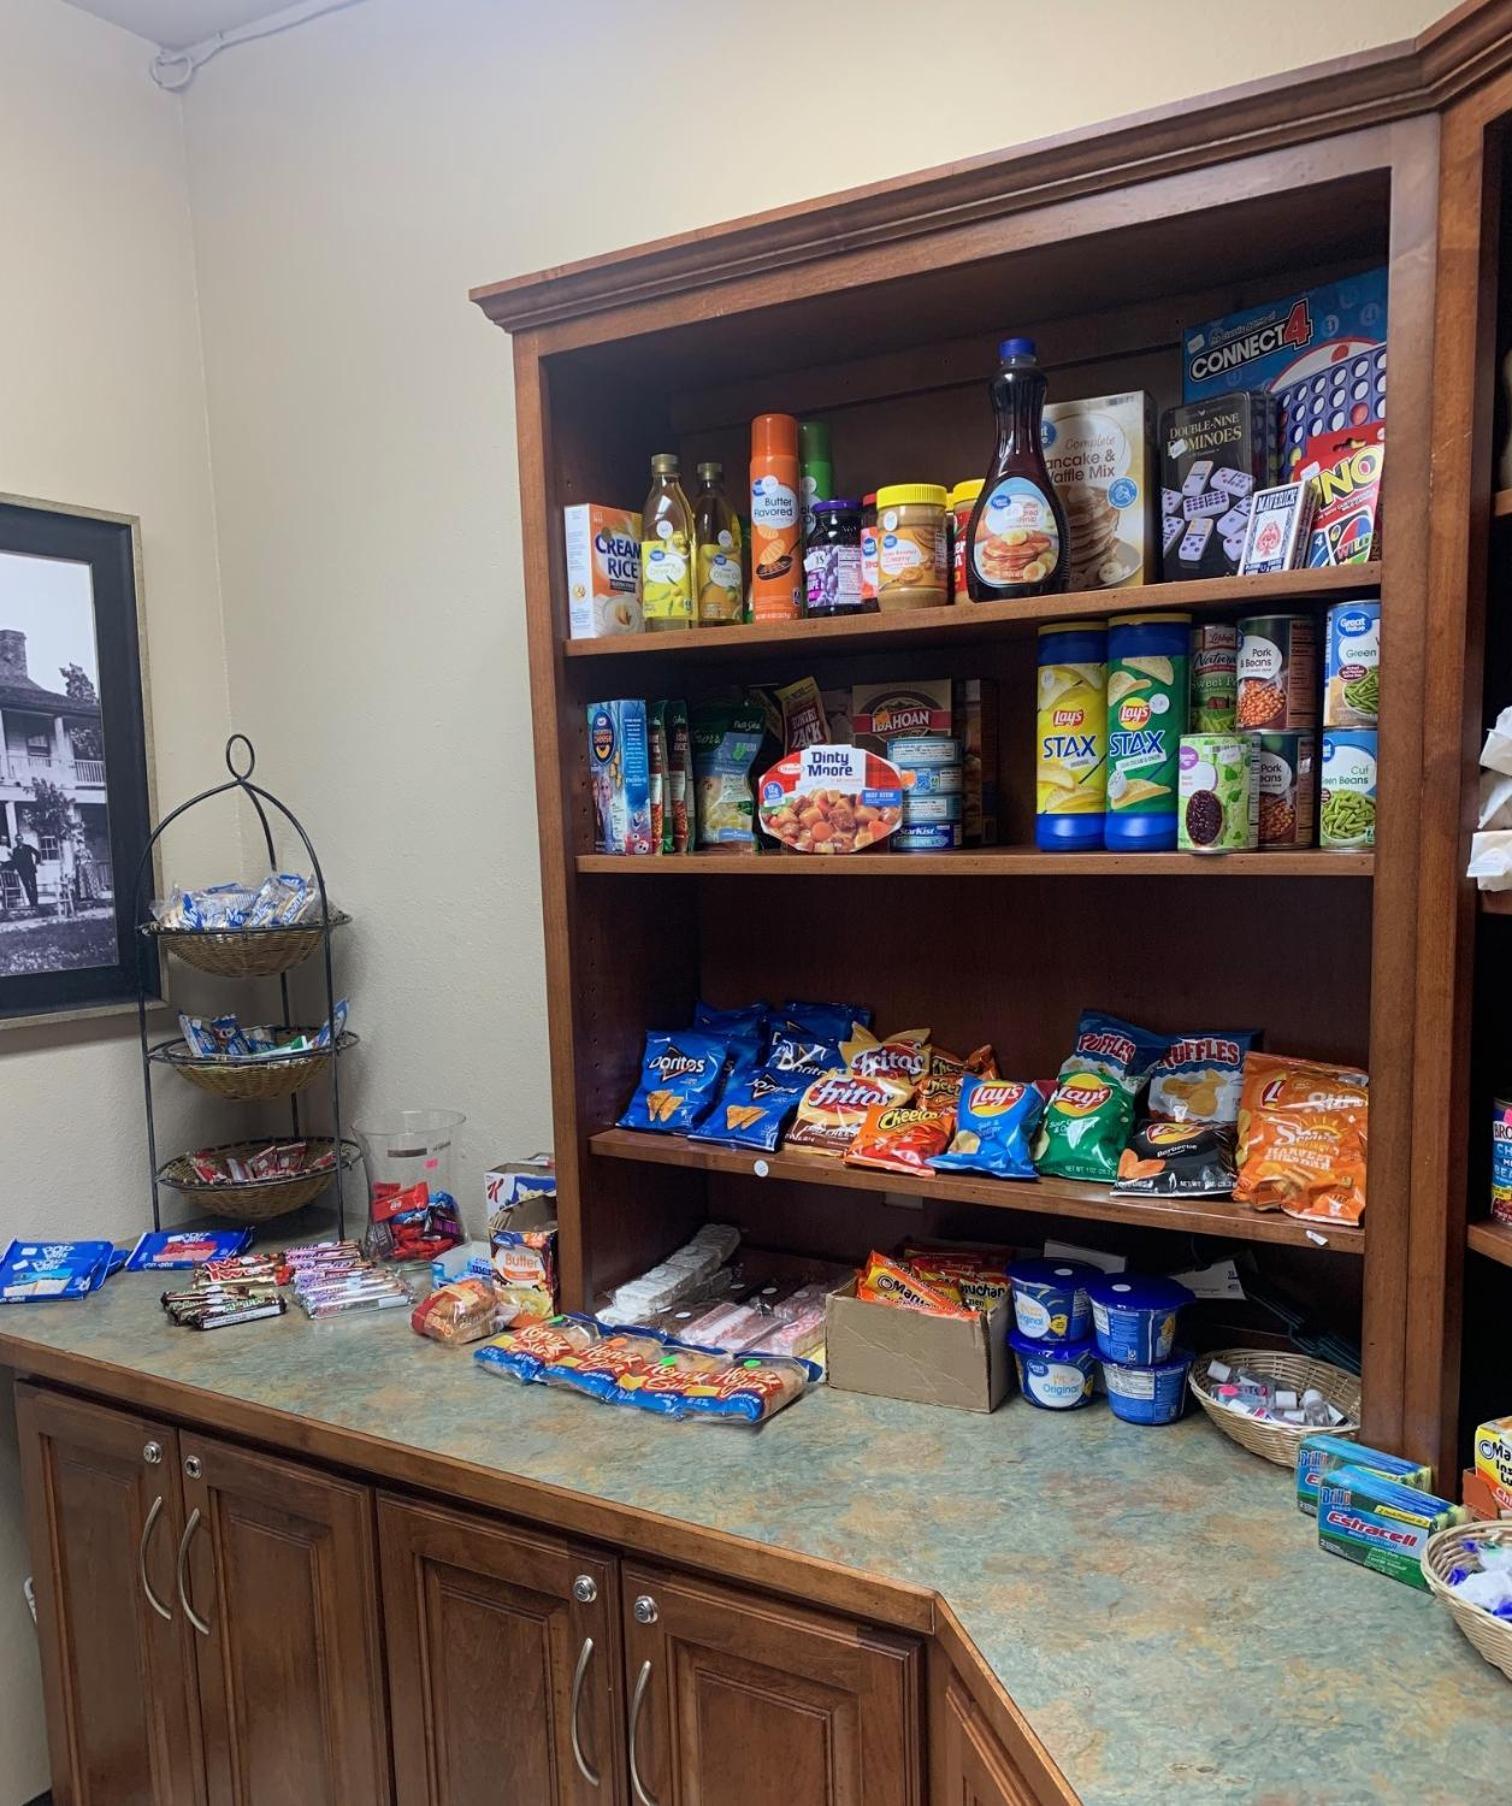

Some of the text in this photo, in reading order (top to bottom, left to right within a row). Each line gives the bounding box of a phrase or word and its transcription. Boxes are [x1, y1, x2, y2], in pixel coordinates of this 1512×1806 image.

[1191, 322, 1286, 379] CONNECT
[1283, 299, 1312, 348] 4
[1169, 412, 1240, 440] DOUBLE-NINE
[1065, 435, 1116, 450] Complete
[1047, 450, 1116, 469] ancake &
[1089, 465, 1116, 480] Mix
[764, 497, 793, 508] Butter
[753, 507, 793, 518] Flavored
[607, 558, 639, 579] RICE
[1252, 648, 1272, 658] Pork
[1345, 649, 1377, 658] Green
[1245, 658, 1272, 668] Beans
[1043, 734, 1097, 759] STAX
[1109, 730, 1166, 757] STAX
[811, 751, 850, 766] Dinty
[1261, 763, 1282, 773] Pork
[1350, 765, 1369, 775] Cut
[1260, 774, 1282, 783] eans
[1339, 775, 1369, 785] Beans
[1078, 1033, 1137, 1065] RUFFLES
[648, 1055, 706, 1073] Doritos
[808, 1077, 894, 1107] Fritos
[879, 1108, 943, 1130] Cheetos
[487, 1178, 505, 1203] K
[504, 1253, 539, 1268] Butter
[1043, 1383, 1080, 1396] Original
[1320, 1486, 1352, 1506] Brillo
[1326, 1510, 1418, 1547] Estracell
